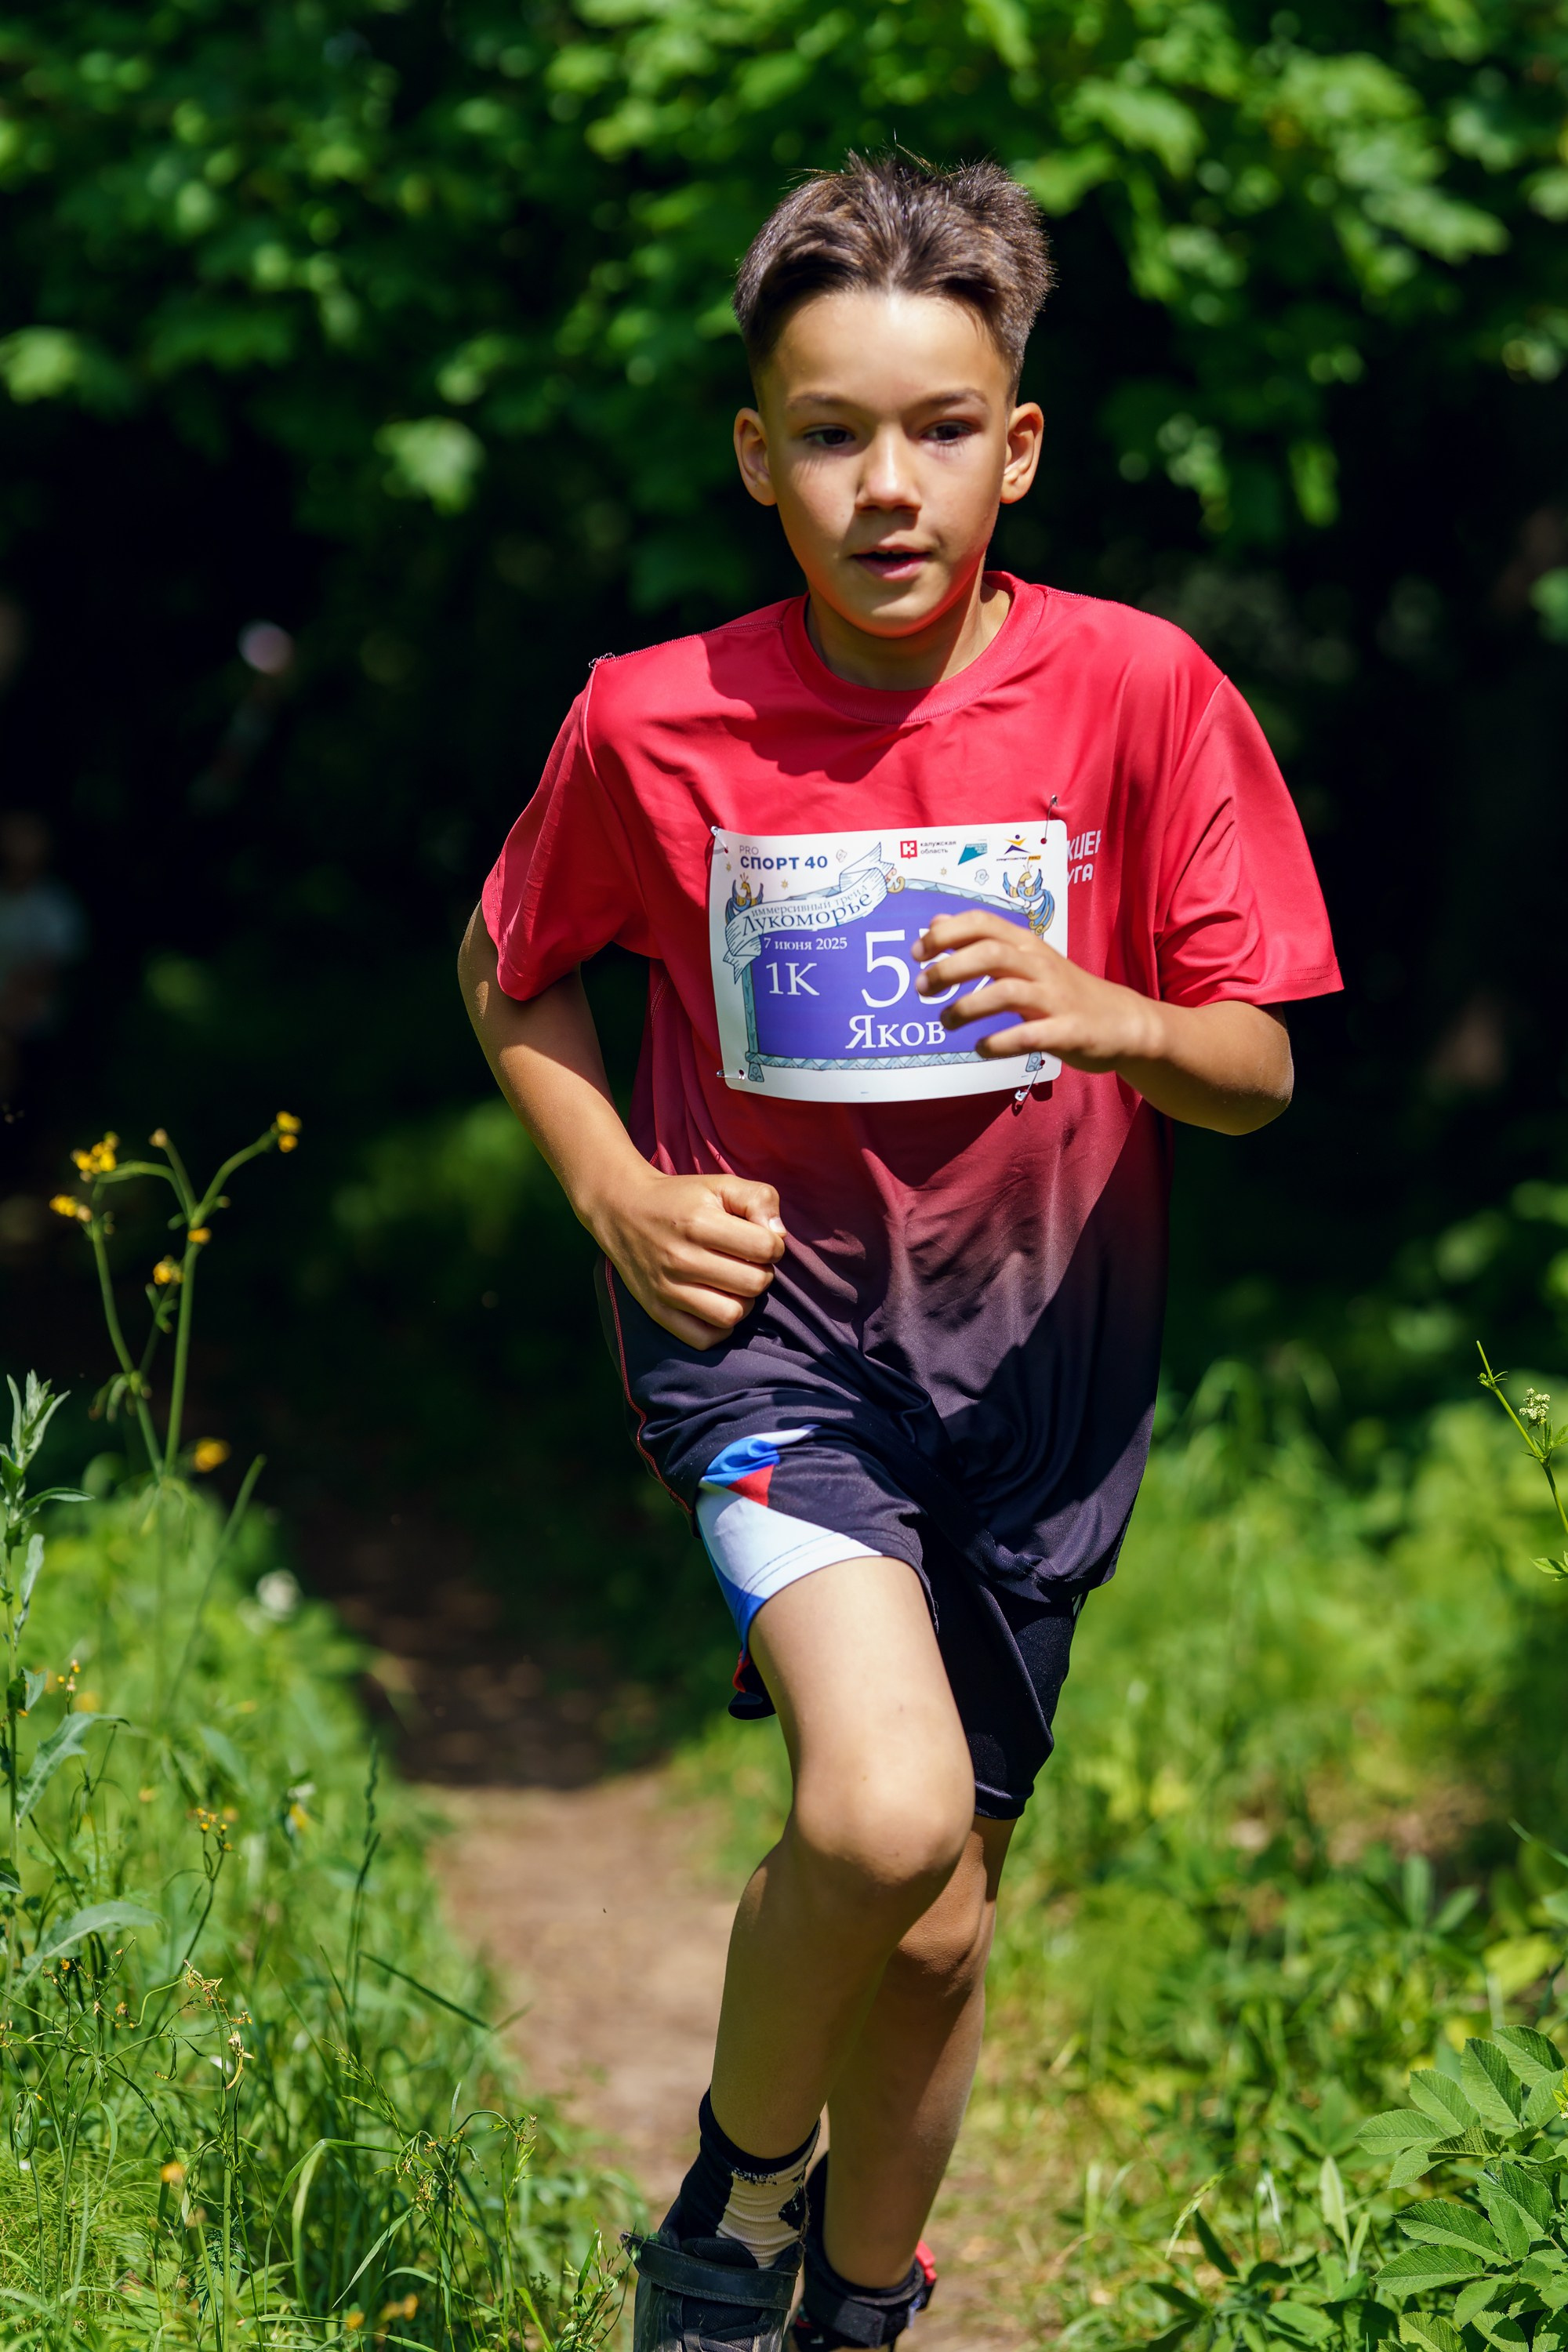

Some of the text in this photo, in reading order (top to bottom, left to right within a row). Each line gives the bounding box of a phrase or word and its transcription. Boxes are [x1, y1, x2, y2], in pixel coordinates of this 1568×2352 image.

[739, 844, 759, 855] PRO
[740, 855, 828, 869] СПОРТ 40
[742, 892, 873, 937] Лукоморье
[764, 937, 848, 950] 7 июня 2025
[861, 927, 992, 1009] 55
[844, 1014, 947, 1050] Яков
